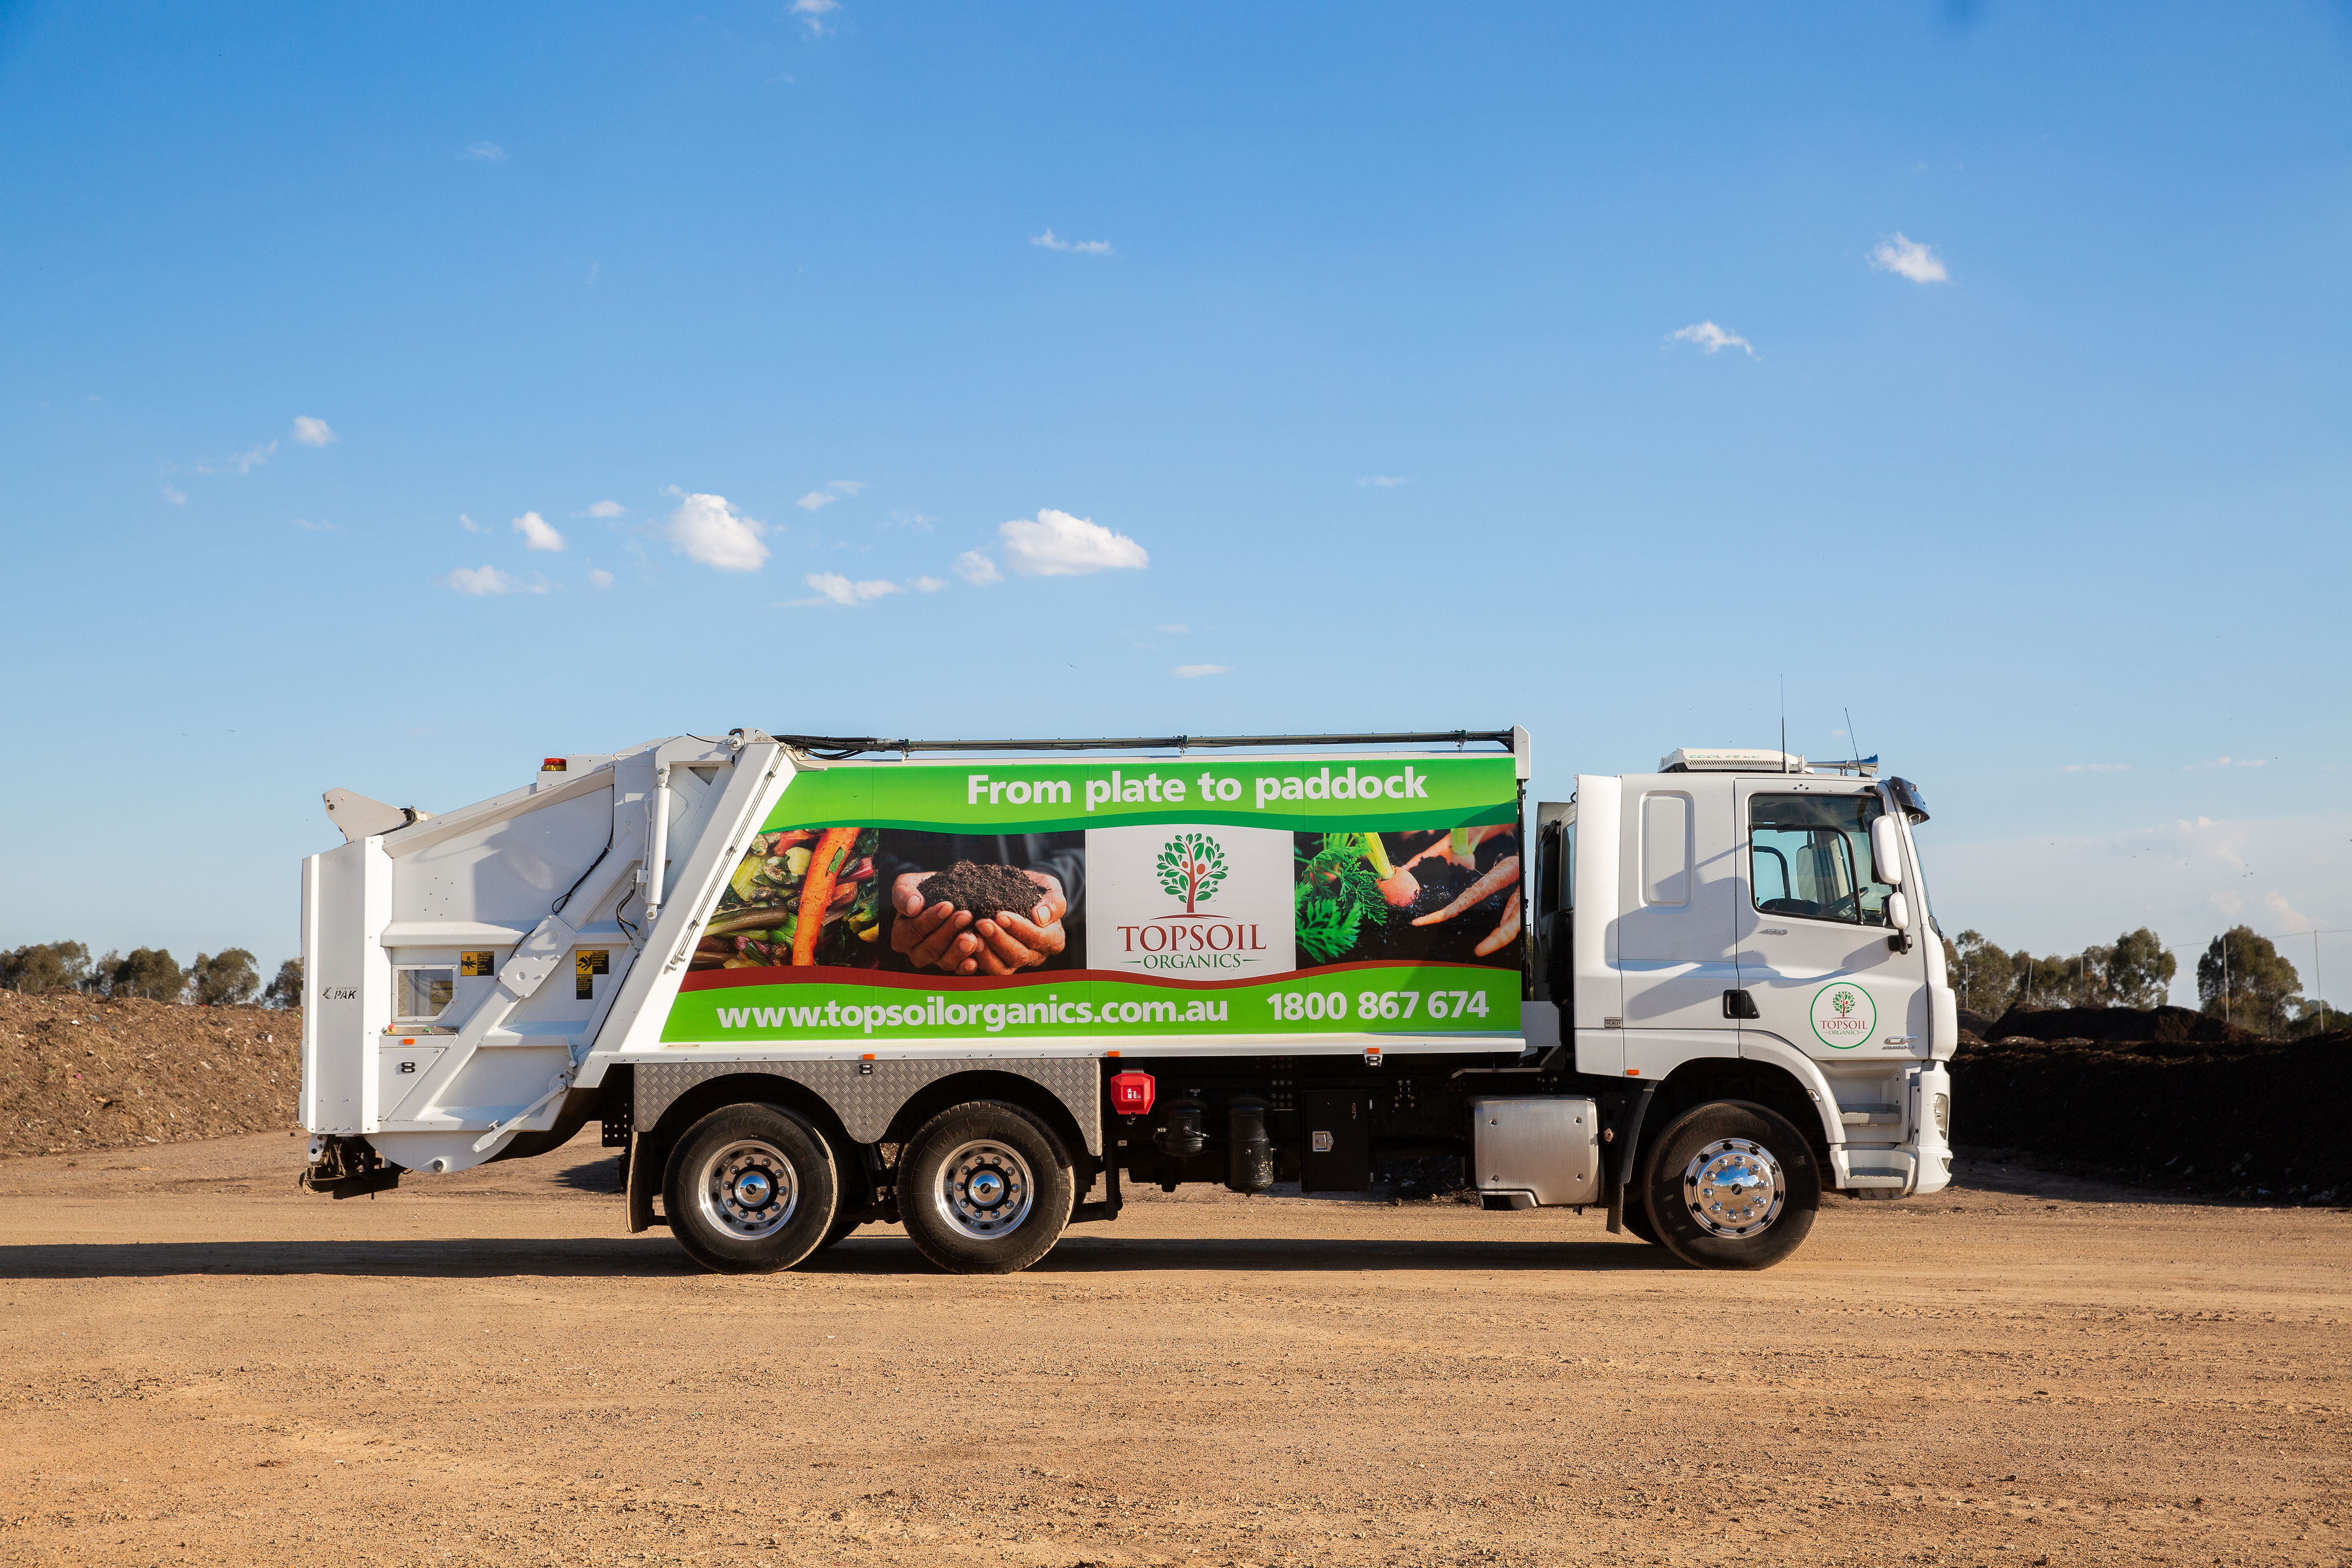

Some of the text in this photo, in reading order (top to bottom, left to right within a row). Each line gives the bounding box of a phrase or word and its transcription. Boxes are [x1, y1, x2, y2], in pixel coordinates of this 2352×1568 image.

[968, 766, 1429, 811] From plate to paddock
[1117, 924, 1267, 952] TOPSOIL
[1143, 953, 1241, 970] ORGANICS
[334, 990, 357, 999] PAK
[1266, 990, 1490, 1021] 1800 867 674
[717, 995, 1228, 1034] www.topsoilorganics.com.au
[1820, 1020, 1868, 1030] TOPSOIL
[1884, 1036, 1919, 1045] CF
